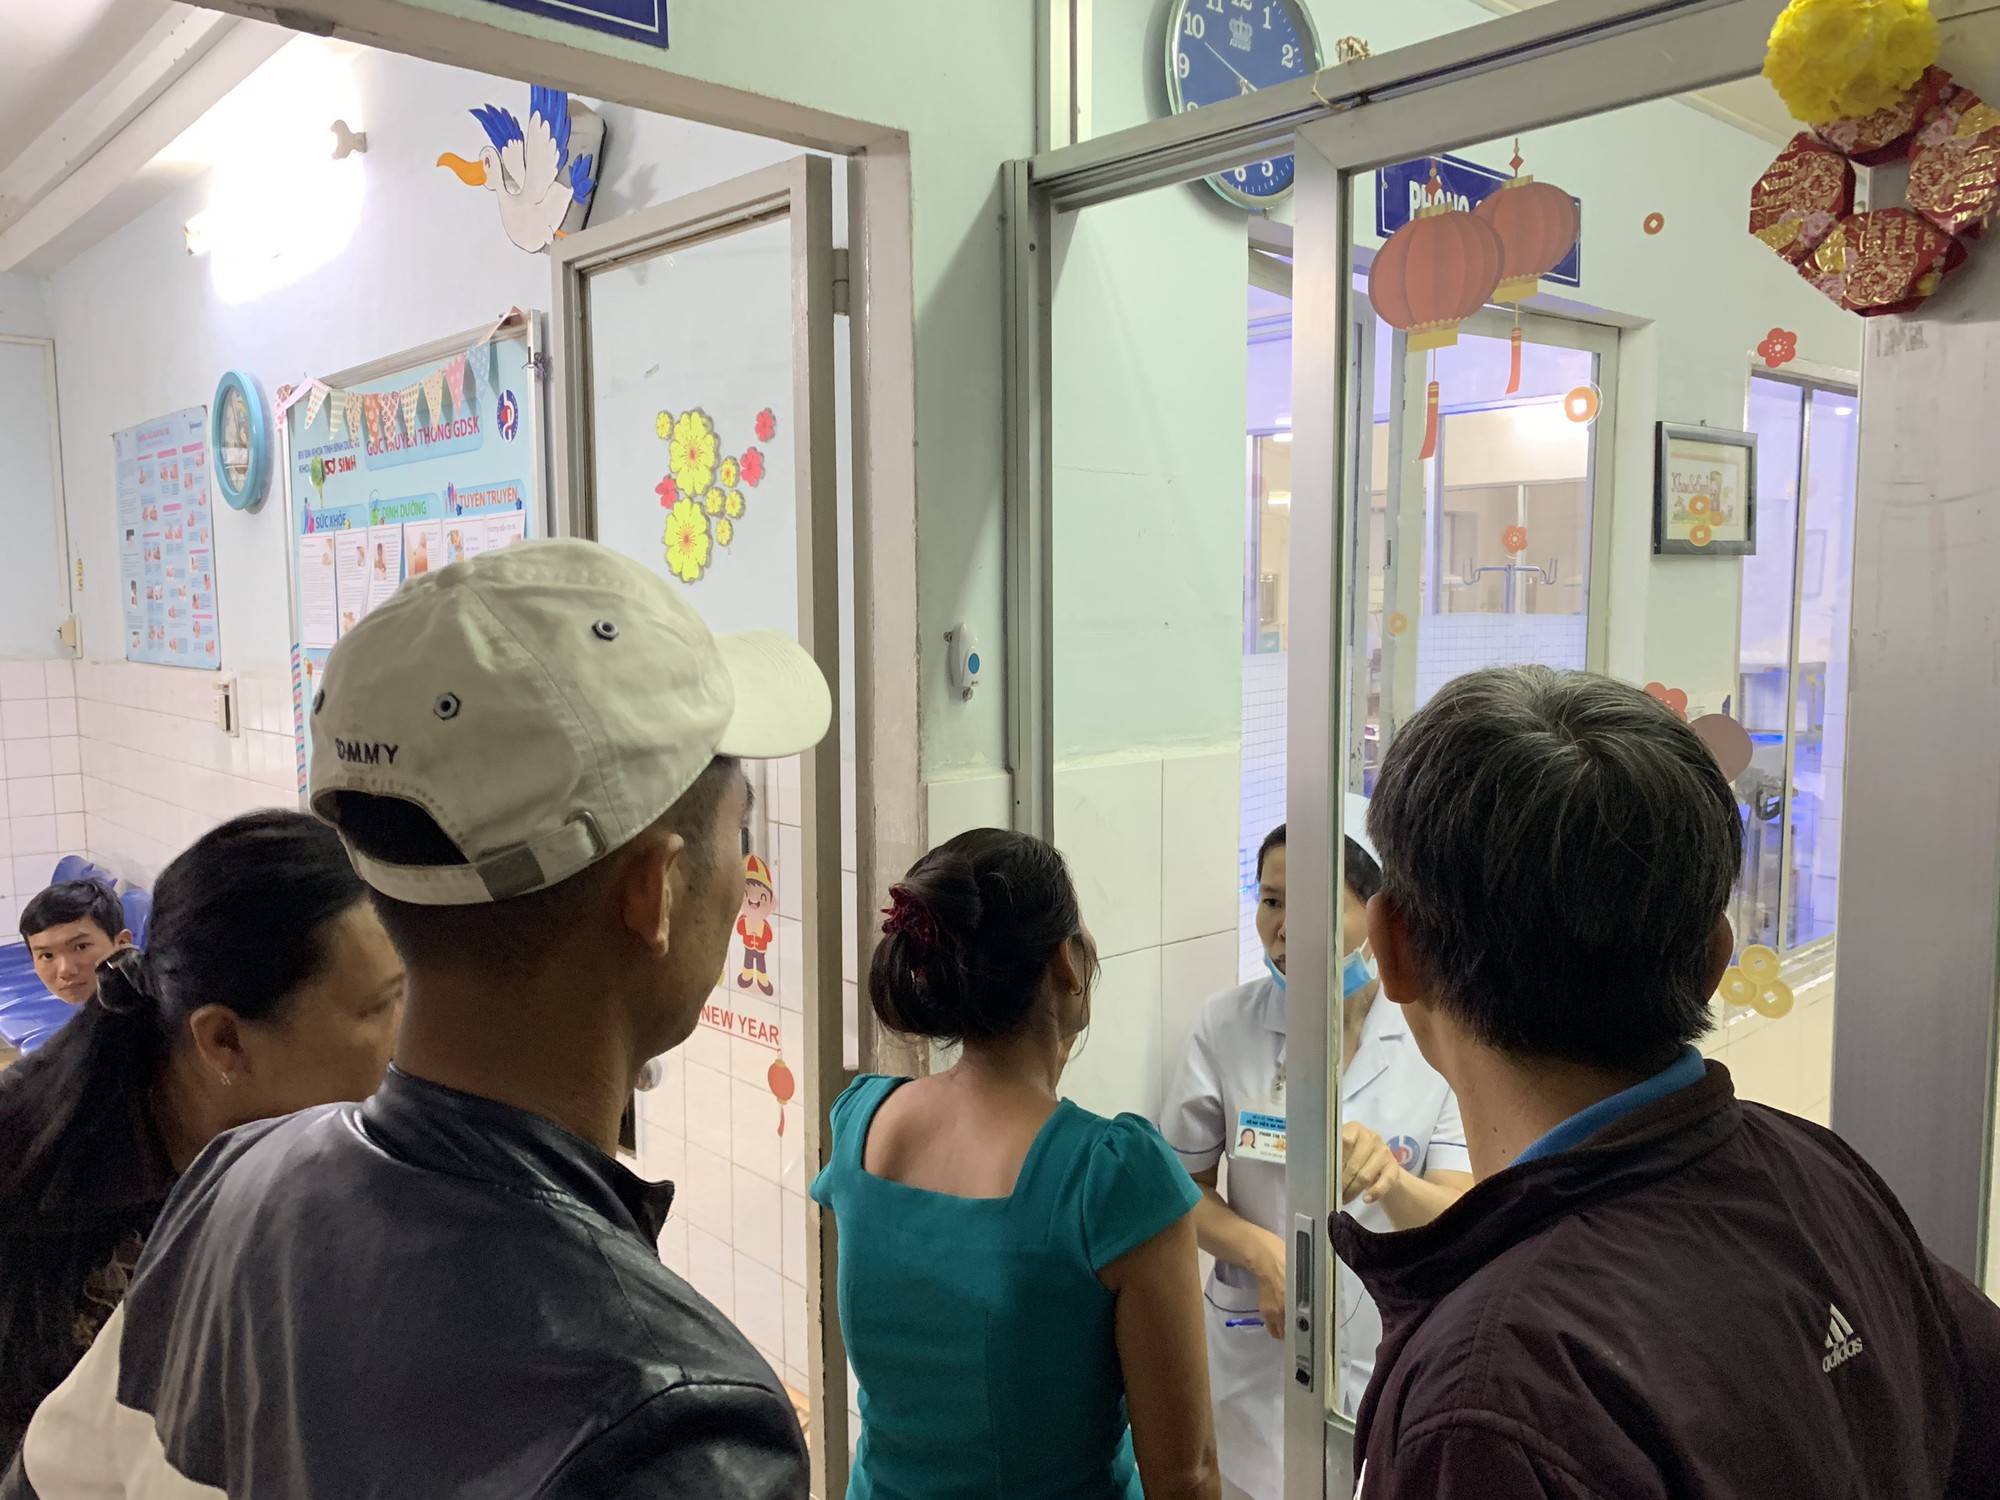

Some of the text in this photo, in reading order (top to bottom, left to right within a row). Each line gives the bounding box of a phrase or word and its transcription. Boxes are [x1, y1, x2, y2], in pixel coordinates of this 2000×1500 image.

[1184, 11, 1205, 39] 10
[1263, 6, 1272, 30] 1
[1178, 52, 1190, 78] 9
[1281, 43, 1294, 68] 2
[453, 415, 480, 438] GDSK
[338, 455, 357, 473] SINH
[701, 1004, 780, 1046] NEW YEAR
[1822, 1337, 1863, 1373] adidas
